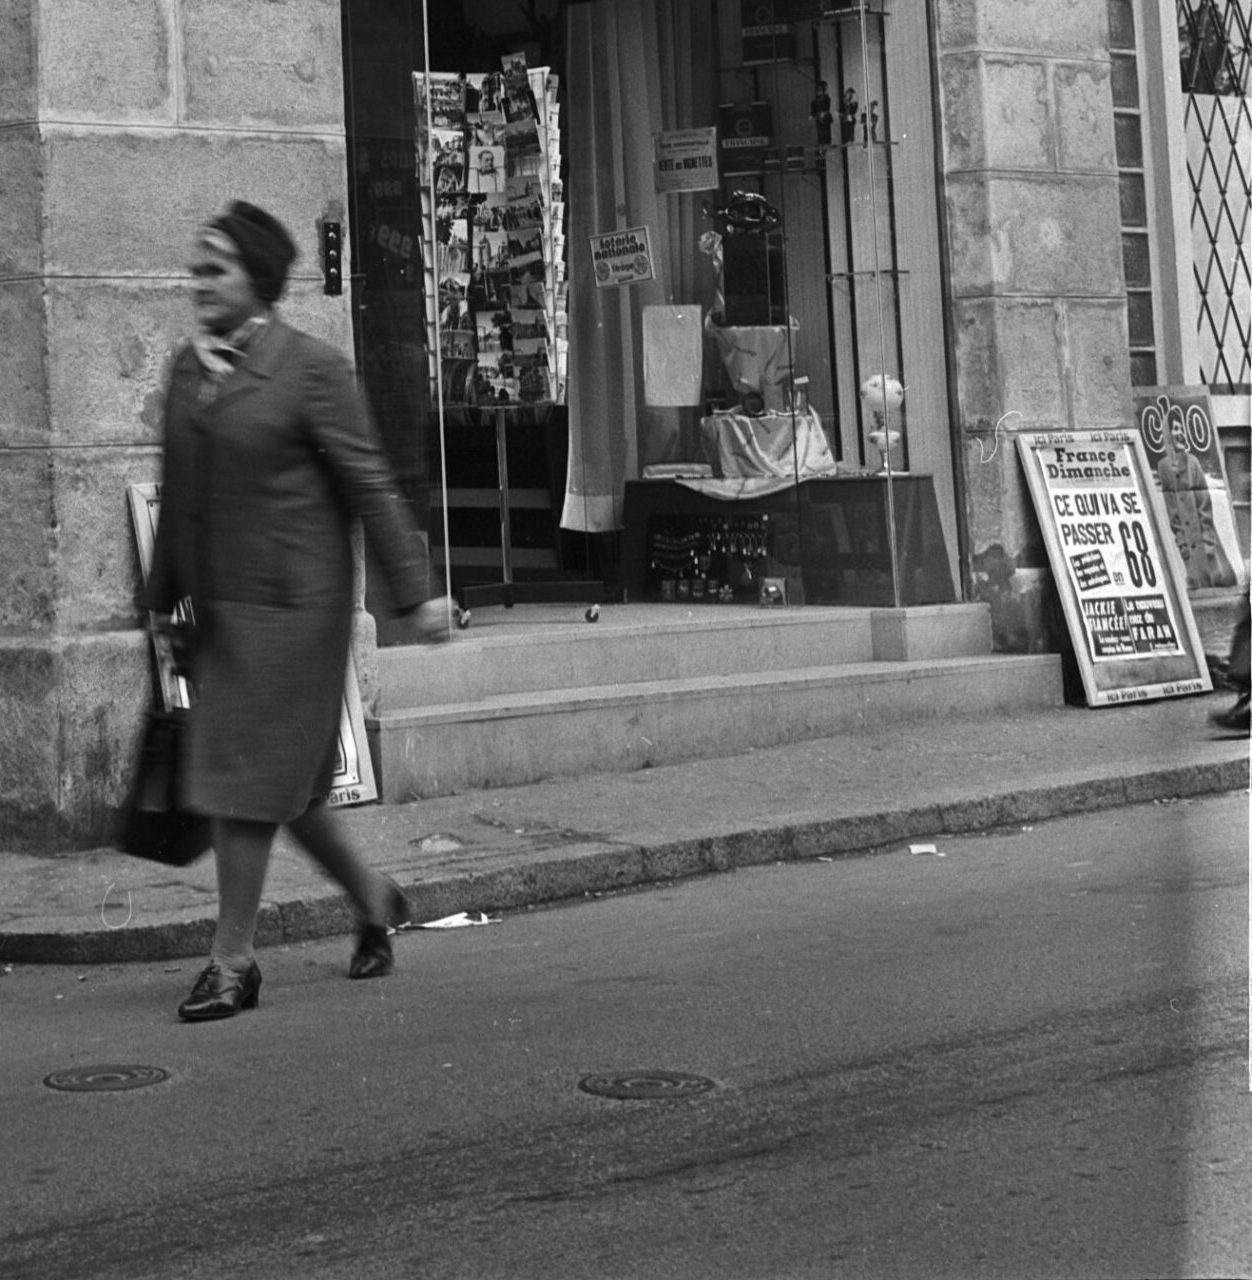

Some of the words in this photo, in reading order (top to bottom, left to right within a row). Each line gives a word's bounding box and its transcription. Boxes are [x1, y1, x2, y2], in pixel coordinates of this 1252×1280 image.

[600, 233, 636, 249] loterie
[595, 242, 645, 261] nationale
[1048, 433, 1075, 445] Paris
[1104, 431, 1131, 442] Paris
[1054, 447, 1117, 464] France
[1046, 463, 1131, 480] Dimanche
[1054, 494, 1074, 518] CE
[1074, 493, 1101, 517] QUI
[1100, 493, 1121, 516] VA
[1121, 491, 1142, 515] SE
[1061, 522, 1116, 547] PASSER
[1118, 520, 1157, 589] 68
[1084, 600, 1117, 616] JACKIE
